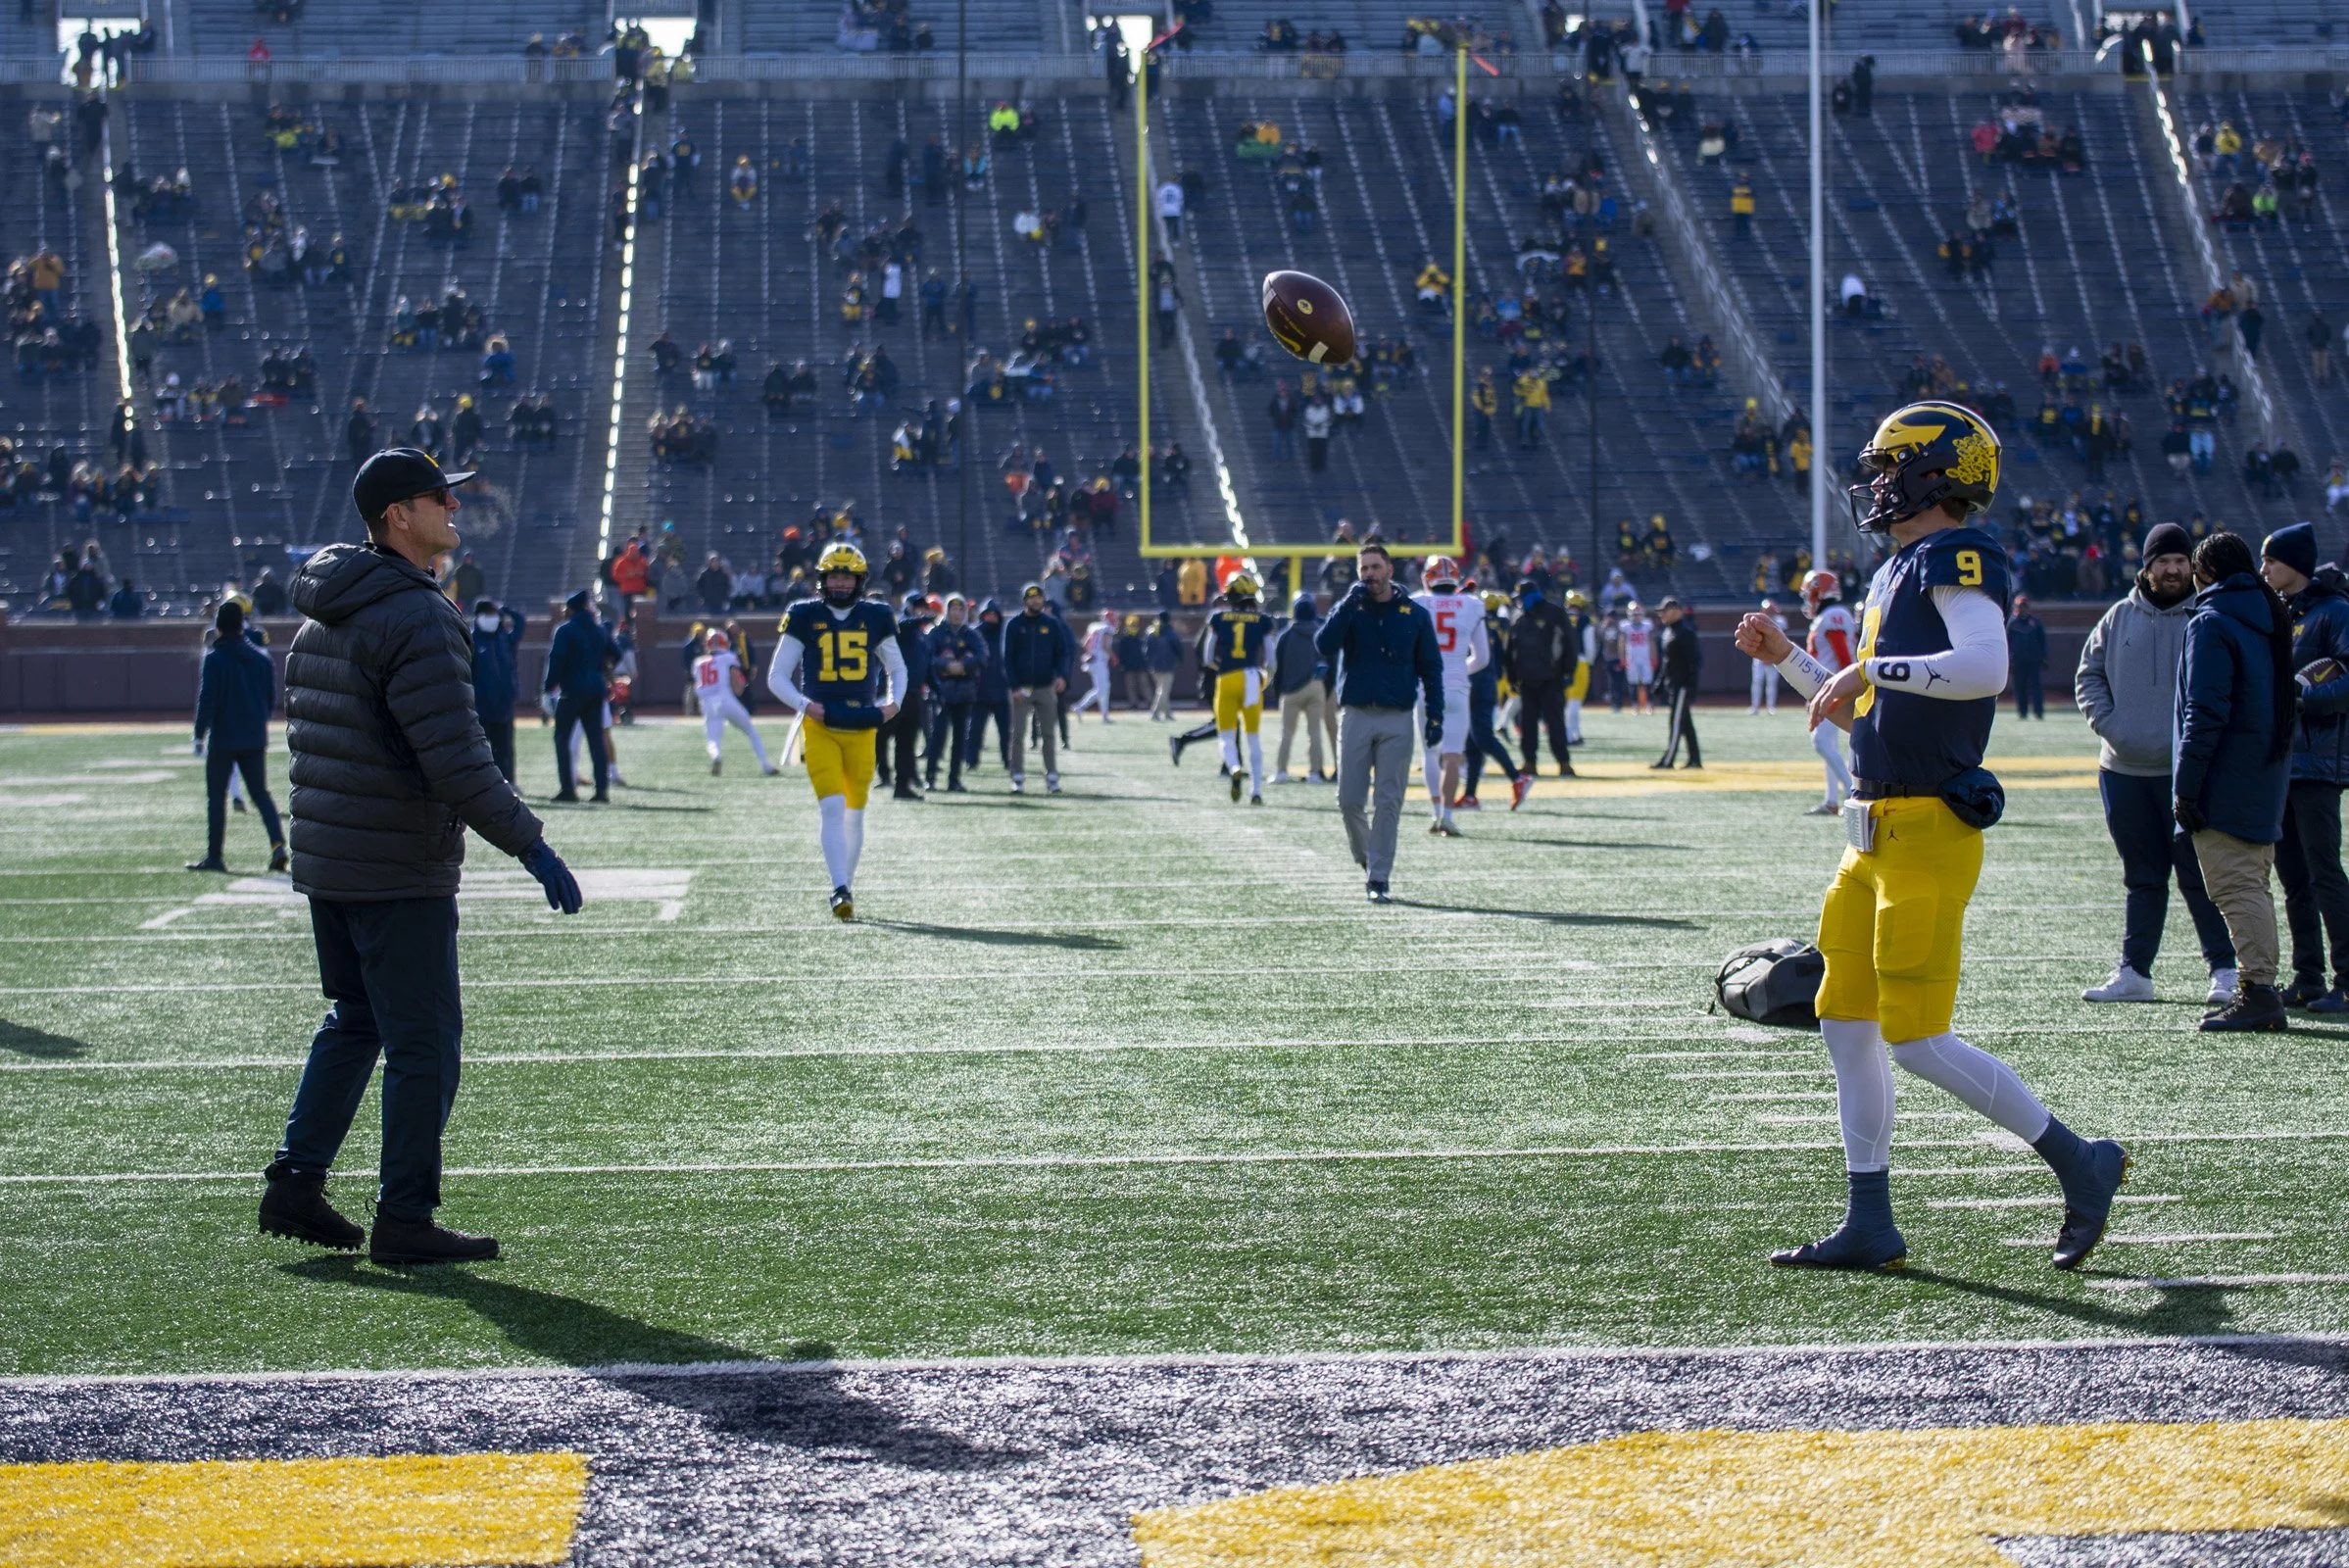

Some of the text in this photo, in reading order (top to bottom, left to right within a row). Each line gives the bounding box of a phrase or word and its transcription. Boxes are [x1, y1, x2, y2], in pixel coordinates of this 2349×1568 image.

[1956, 550, 1982, 586] 9
[1231, 621, 1247, 659] 1
[1436, 612, 1457, 652] 5
[701, 662, 718, 687] 16
[817, 630, 868, 682] 15
[1797, 660, 1813, 673] 15
